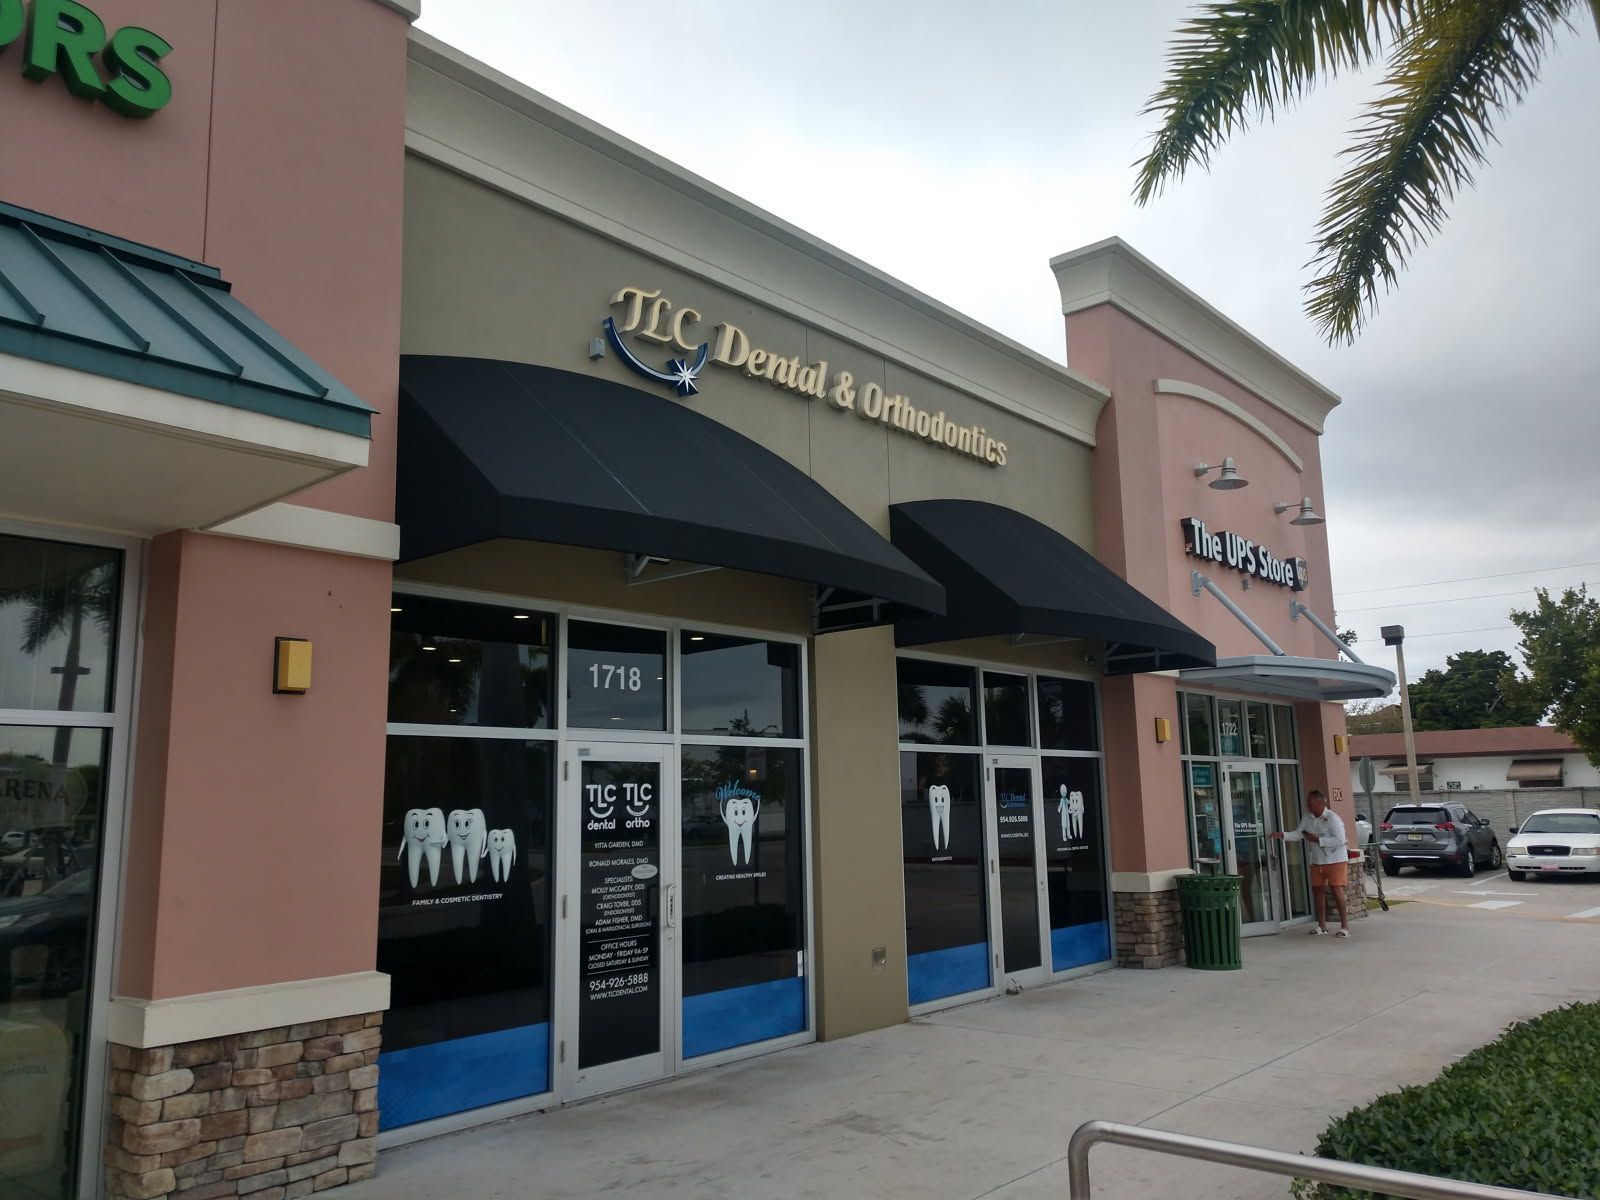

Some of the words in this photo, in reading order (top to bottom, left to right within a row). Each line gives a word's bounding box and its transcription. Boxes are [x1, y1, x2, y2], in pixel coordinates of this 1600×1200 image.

[610, 287, 702, 352] TLC
[708, 320, 828, 399] Dental
[829, 370, 856, 411] &
[857, 381, 1008, 467] Orthodontics
[1189, 517, 1223, 563] The
[1224, 531, 1257, 575] UPS
[1258, 544, 1294, 587] Store
[589, 663, 641, 692] 1718
[1221, 722, 1238, 736] 1722
[585, 784, 617, 808] TLC
[622, 783, 652, 806] TLC
[715, 779, 761, 800] Welcome
[587, 818, 616, 831] dental
[625, 817, 650, 828] ortho
[589, 860, 611, 868] RONALD
[412, 898, 435, 906] FAMILY
[440, 895, 471, 904] COSMETIC
[471, 893, 503, 902] DENTISTRY
[595, 918, 612, 926] ADAM
[600, 942, 619, 951] OFFICE
[619, 940, 638, 948] HOURS
[588, 951, 614, 962] MONDAY
[616, 949, 634, 958] FRIDAY
[605, 958, 628, 967] SATURDAY
[589, 972, 649, 992] 954-926-5888
